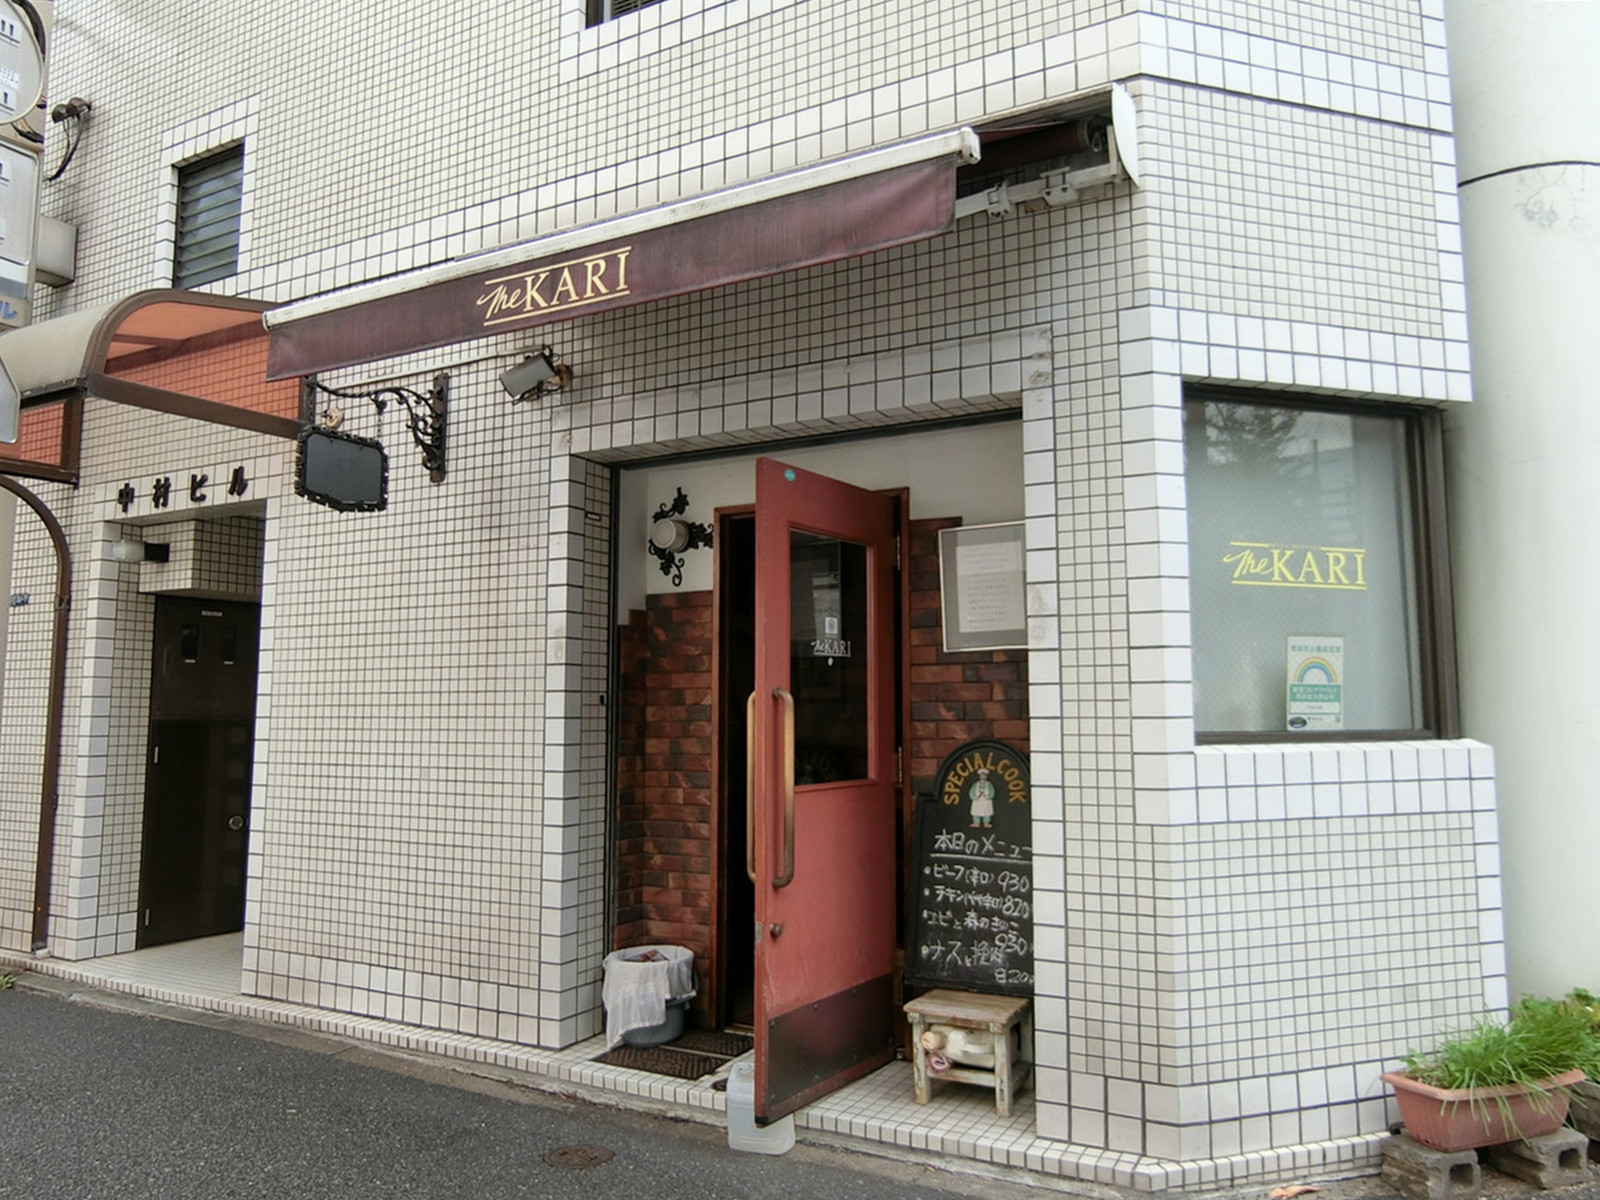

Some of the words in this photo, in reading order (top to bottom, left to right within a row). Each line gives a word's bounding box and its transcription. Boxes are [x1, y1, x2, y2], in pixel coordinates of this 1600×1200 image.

[523, 252, 629, 311] KARI
[1271, 549, 1366, 585] KARI
[943, 752, 996, 805] SPECIAL
[996, 759, 1026, 804] COOK
[934, 828, 1033, 858] 本日のメニュー
[998, 870, 1030, 892] 930
[1002, 894, 1030, 919] 820
